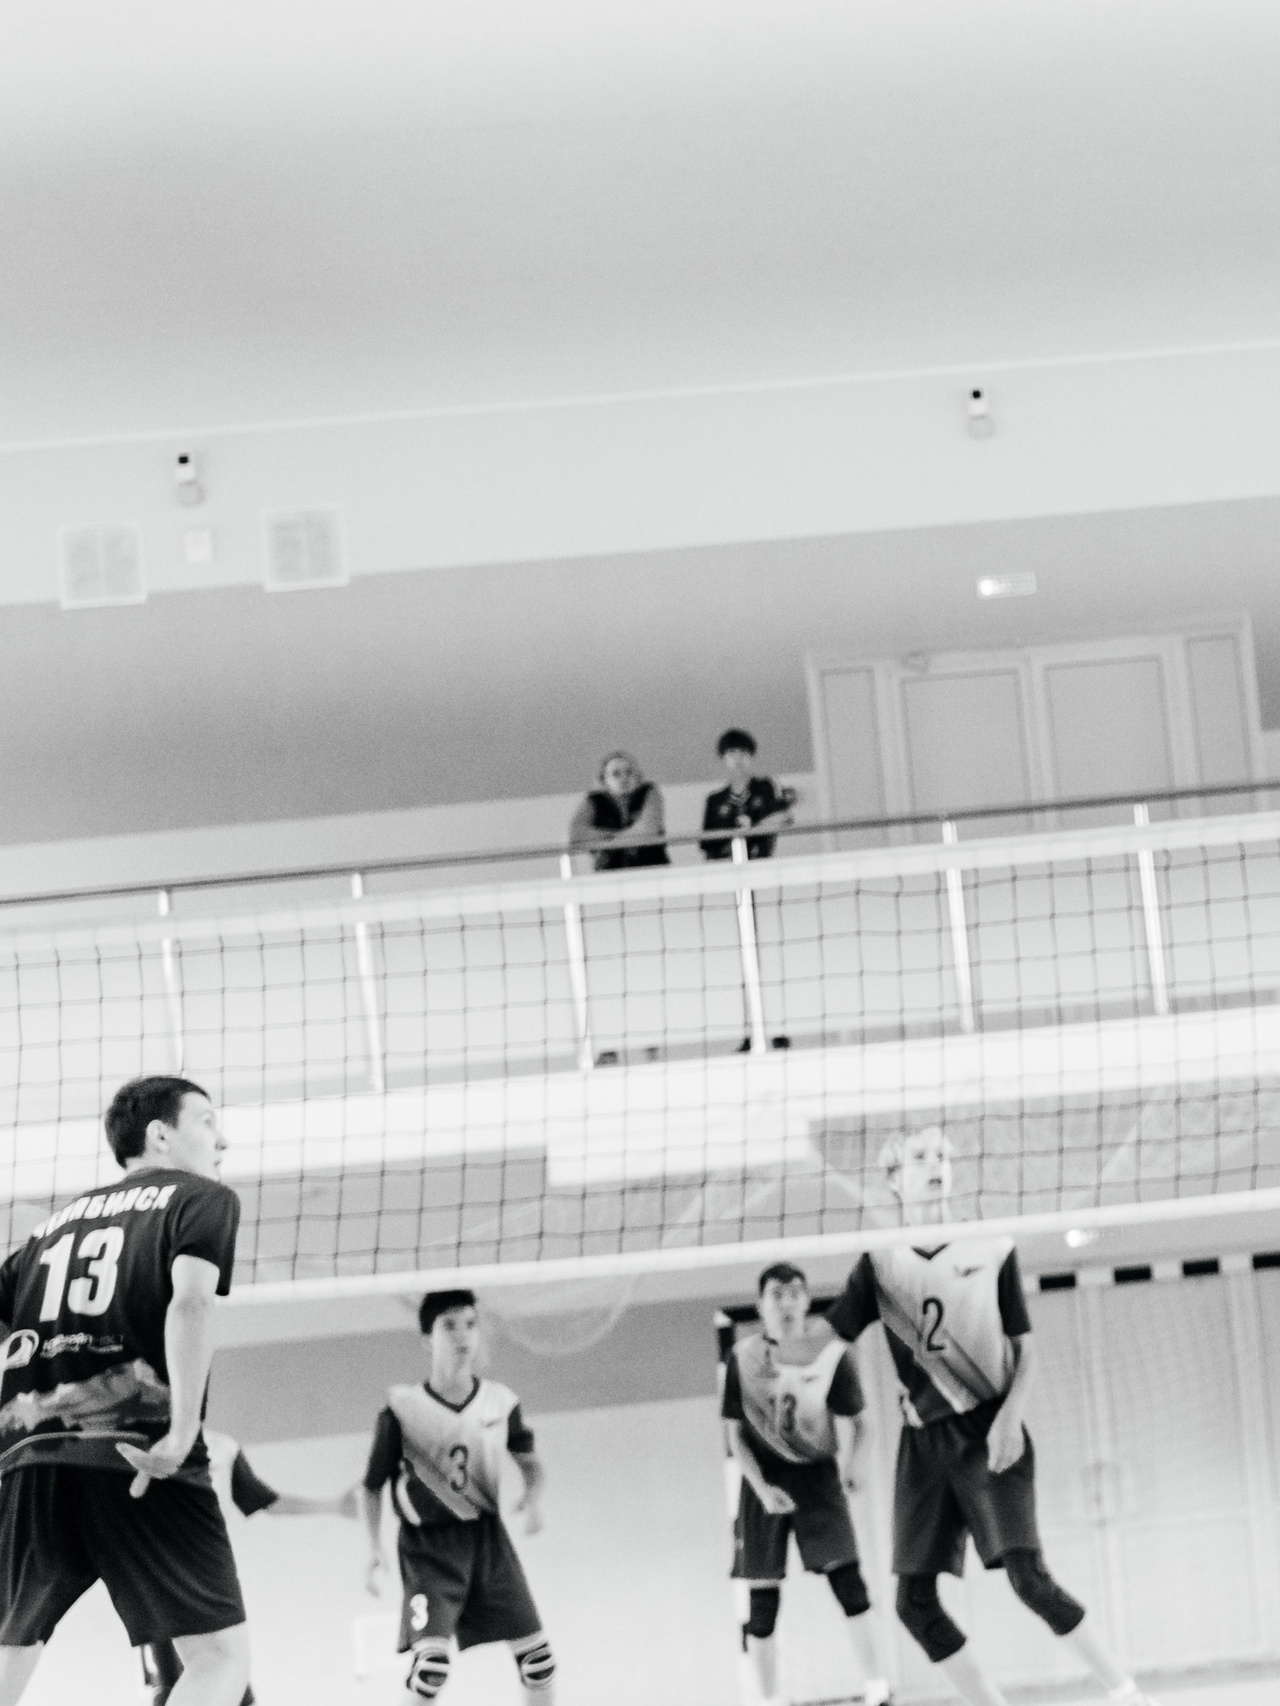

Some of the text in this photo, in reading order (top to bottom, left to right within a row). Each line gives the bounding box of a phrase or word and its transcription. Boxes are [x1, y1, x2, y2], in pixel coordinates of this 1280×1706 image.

[39, 1226, 125, 1322] 13
[922, 1297, 945, 1351] 2
[449, 1444, 469, 1494] 3
